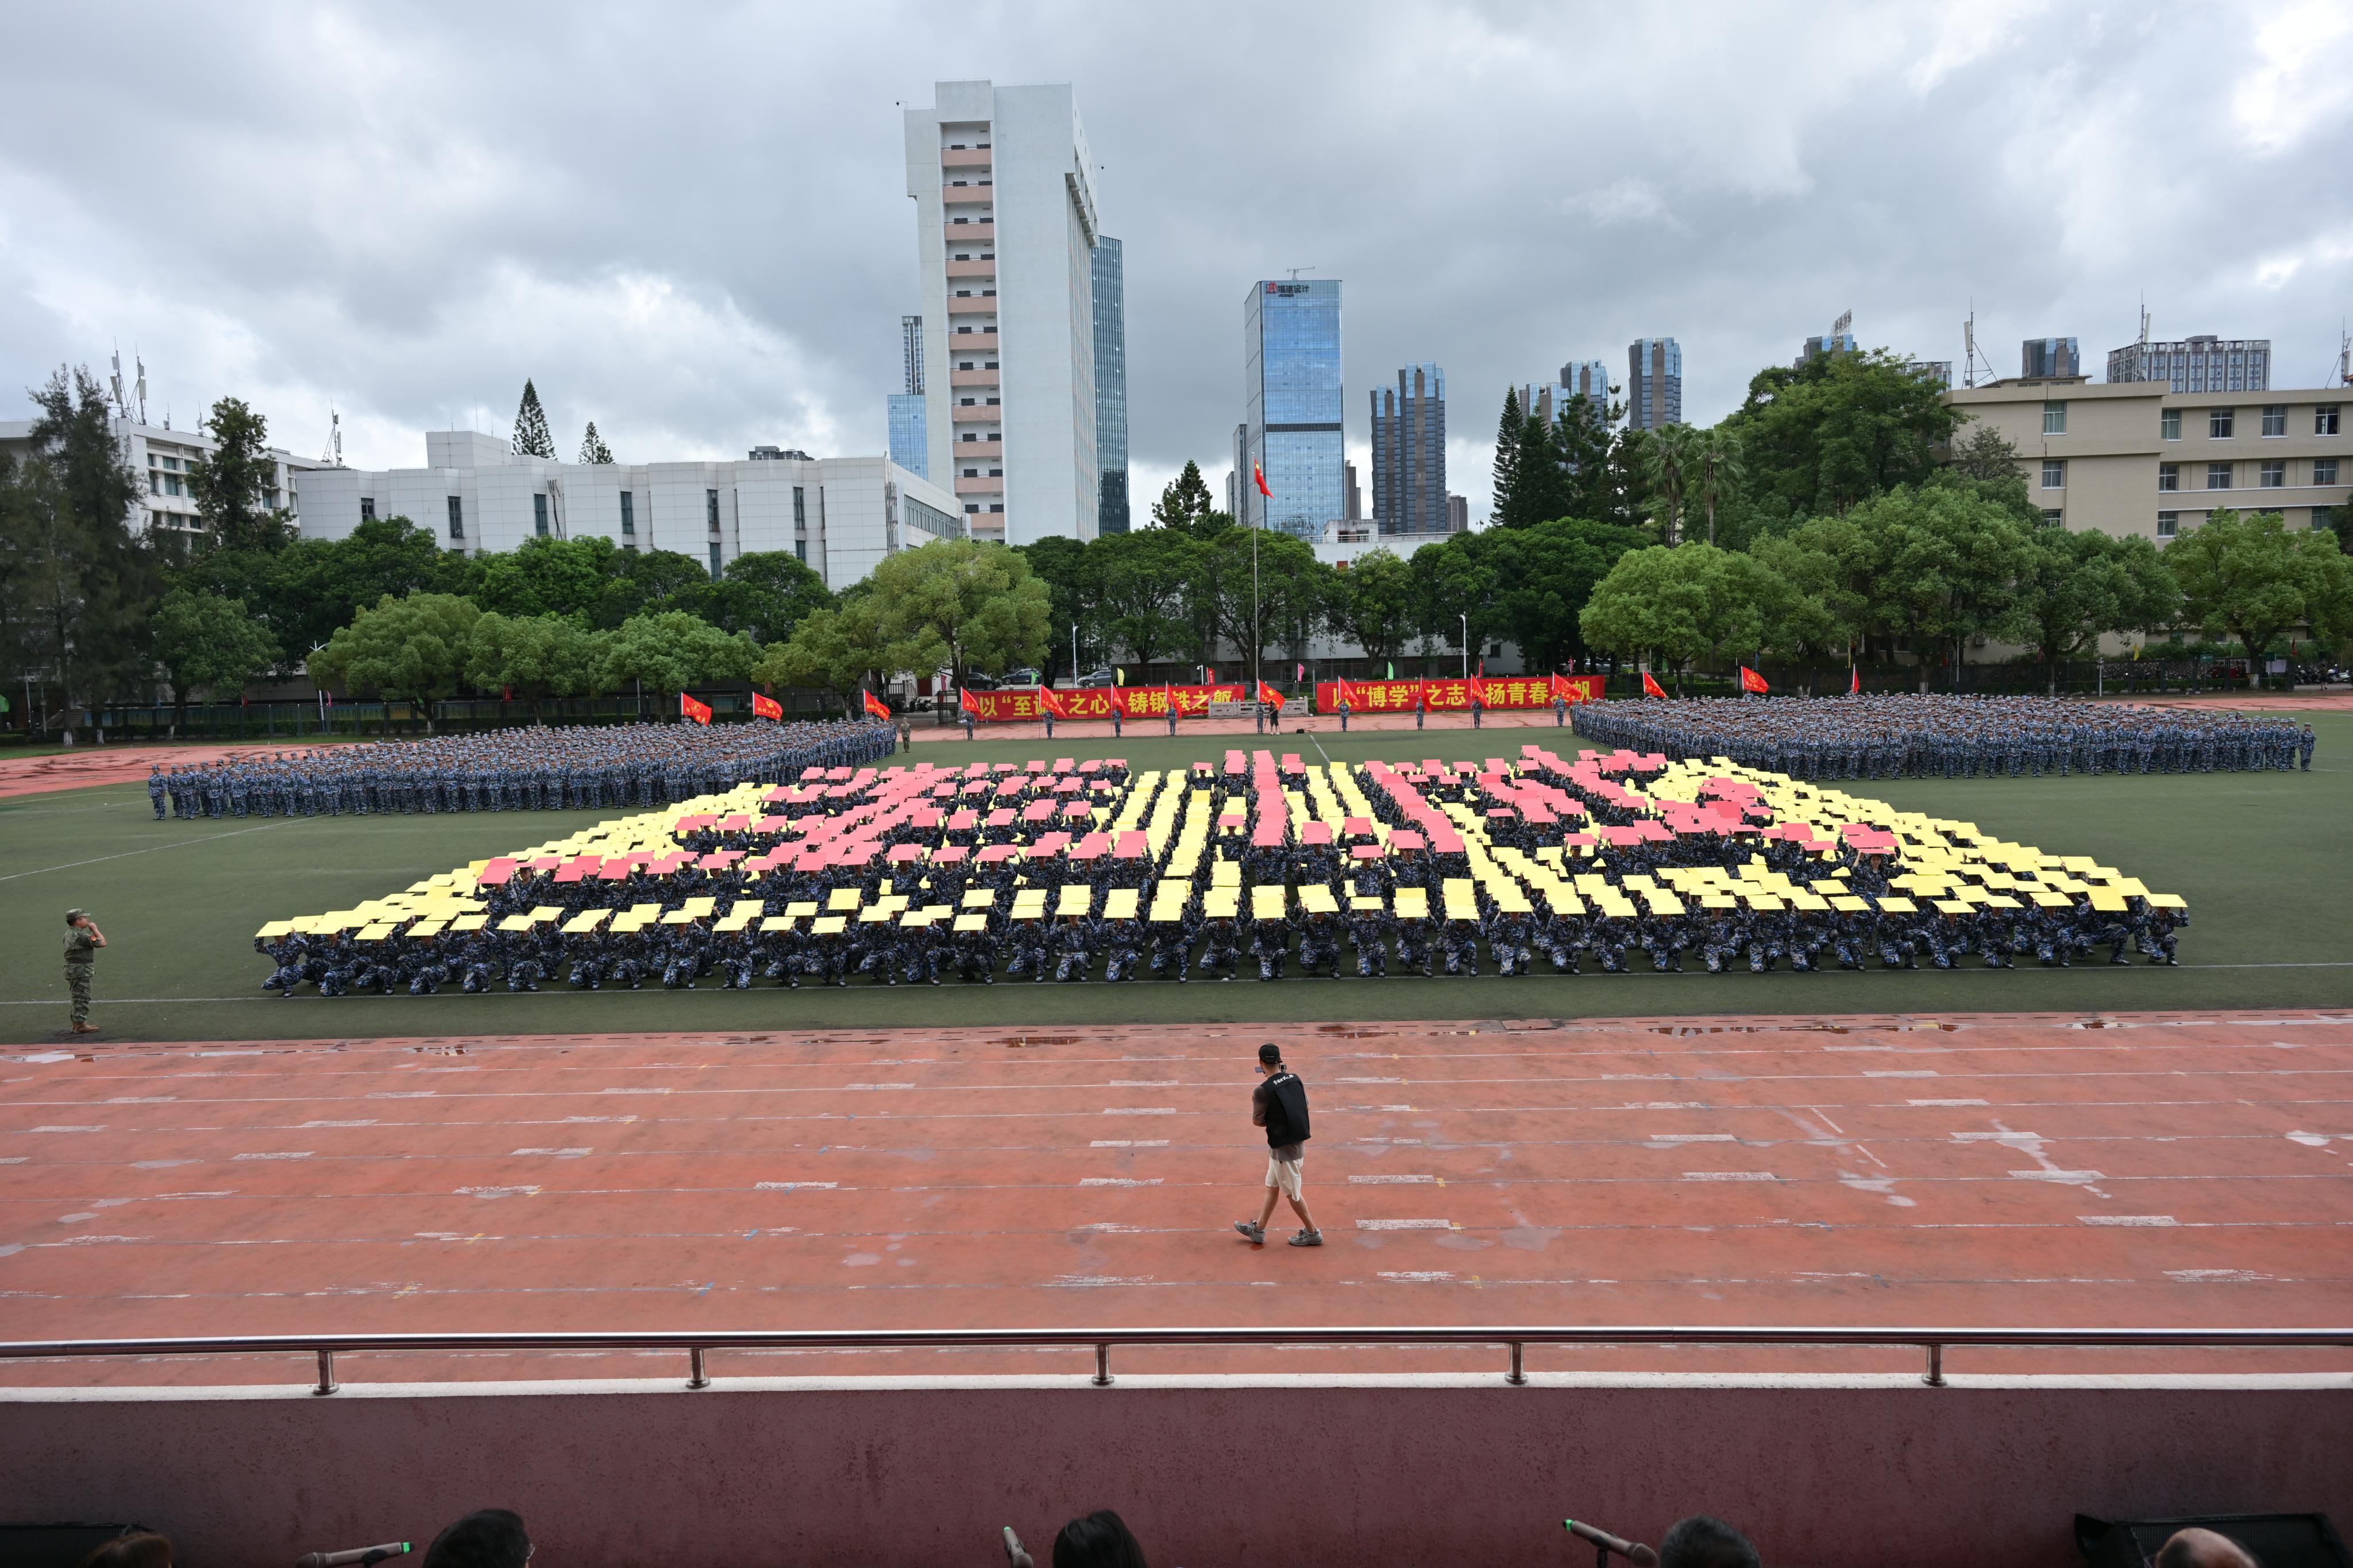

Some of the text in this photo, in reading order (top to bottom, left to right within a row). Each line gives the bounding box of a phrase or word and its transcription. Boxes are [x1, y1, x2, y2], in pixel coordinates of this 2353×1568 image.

[1277, 284, 1310, 293] 福建设计
[1486, 681, 1592, 705] 扬青春帆
